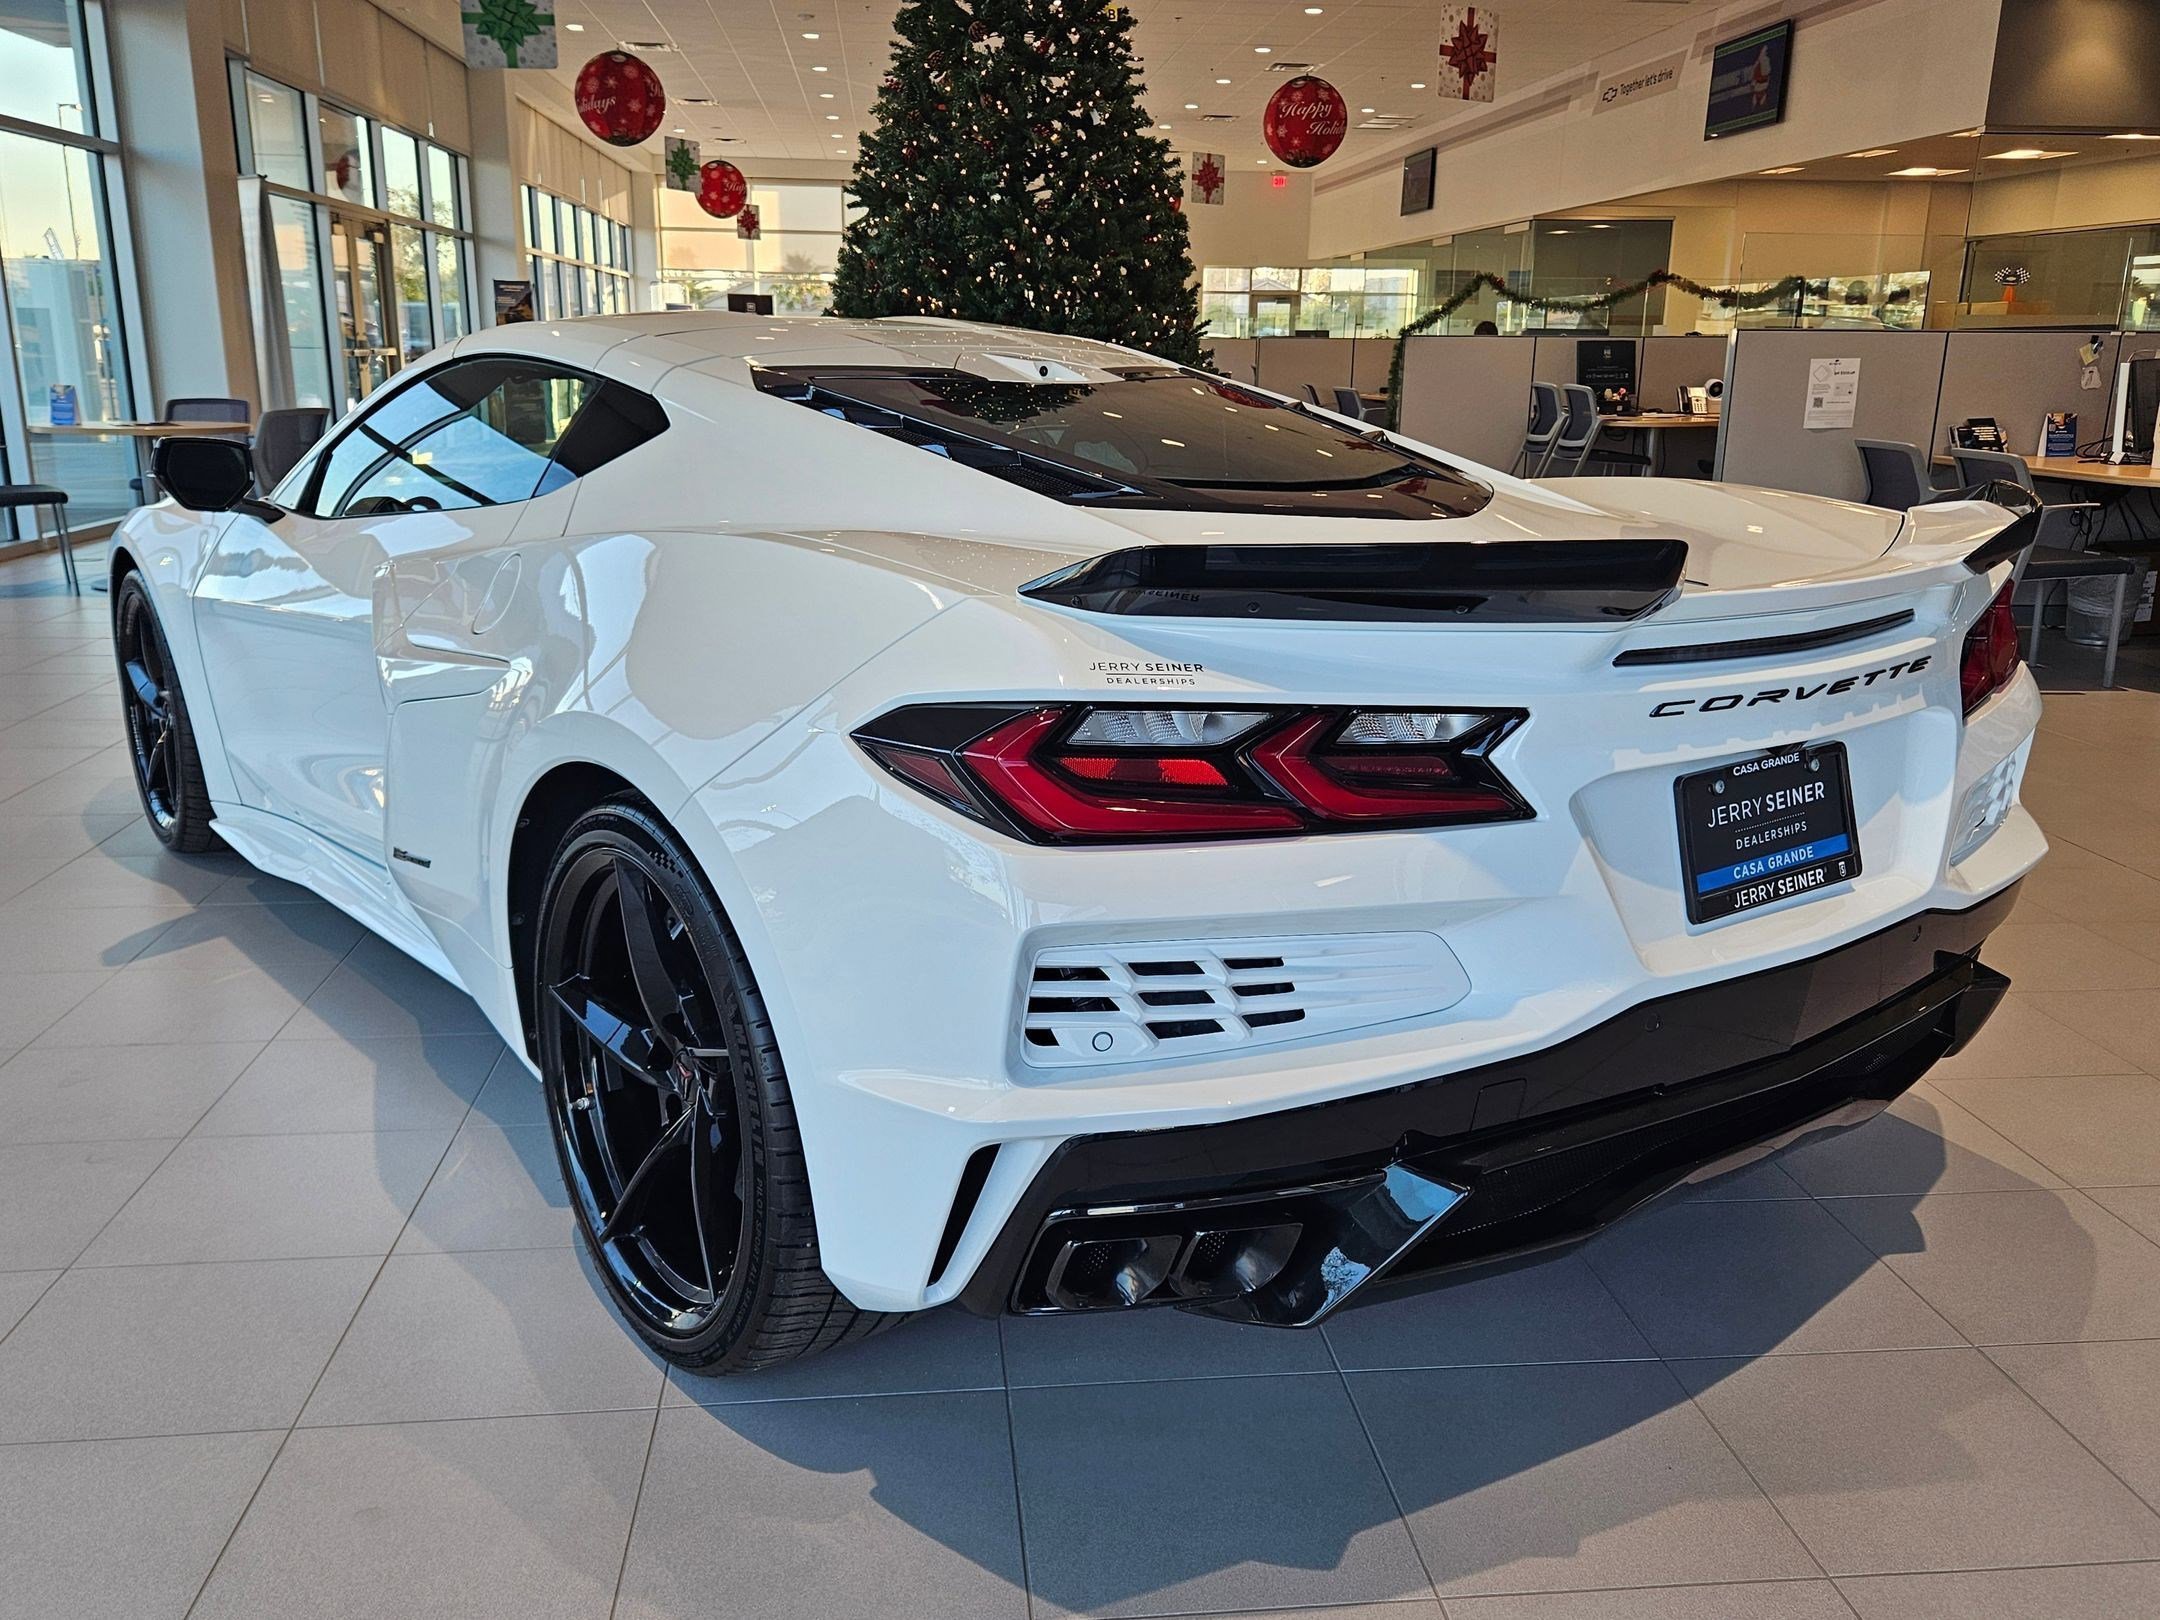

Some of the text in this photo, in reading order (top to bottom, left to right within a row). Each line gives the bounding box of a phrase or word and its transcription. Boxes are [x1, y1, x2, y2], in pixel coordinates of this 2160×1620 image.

[1279, 101, 1332, 120] Happy
[1089, 662, 1204, 672] JERRY SEINER
[1106, 677, 1196, 686] DEALERSHIPS
[1649, 655, 1932, 718] CORVETTE
[1733, 752, 1800, 776] CASA GRANDE
[1707, 781, 1825, 828] JERRY SEINER
[1735, 821, 1808, 850] DEALERSHIPS
[1733, 846, 1814, 880] CASA GRANDE
[1734, 868, 1825, 908] JERRY SEINER
[734, 1023, 765, 1168] MICHELIN
